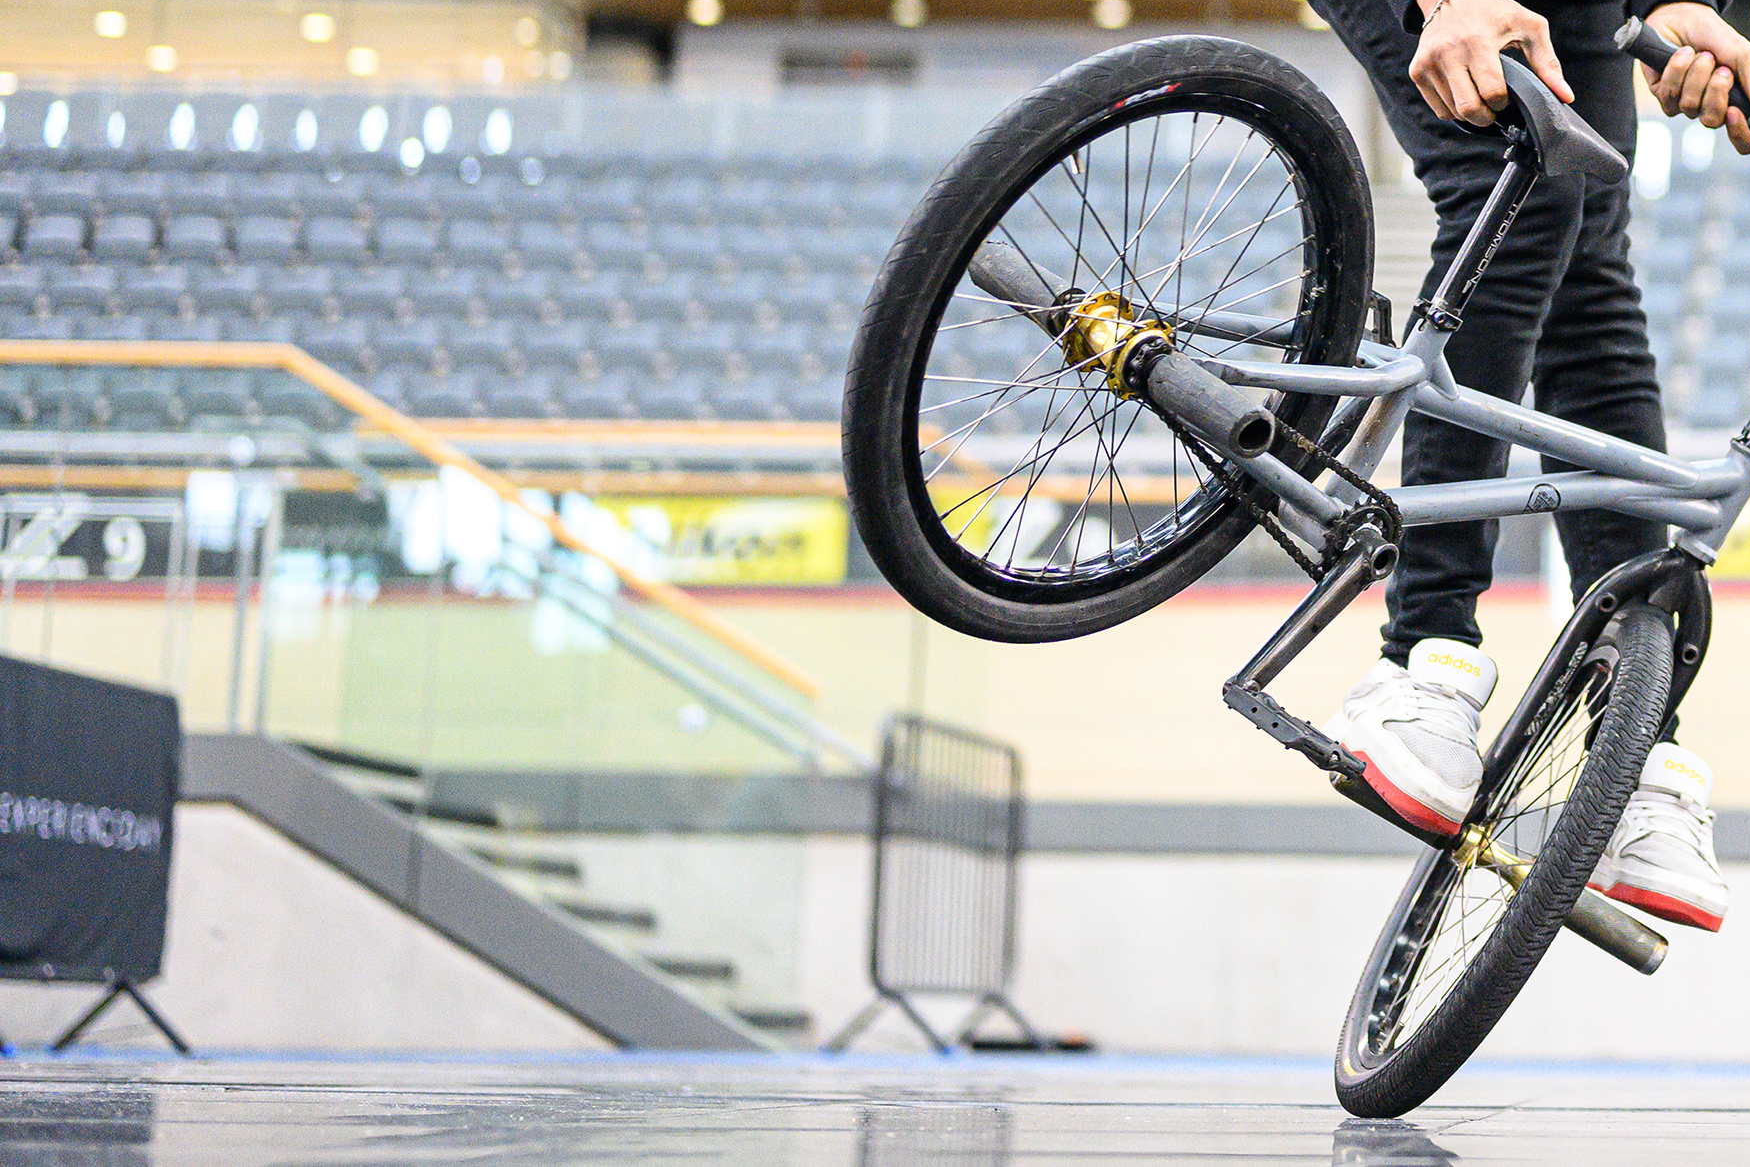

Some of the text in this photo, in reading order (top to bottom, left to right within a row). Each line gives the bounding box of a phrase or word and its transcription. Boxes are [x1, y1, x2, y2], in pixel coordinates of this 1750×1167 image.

[1469, 202, 1520, 284] THOMSON
[103, 515, 147, 582] 9
[1427, 653, 1481, 677] adidas
